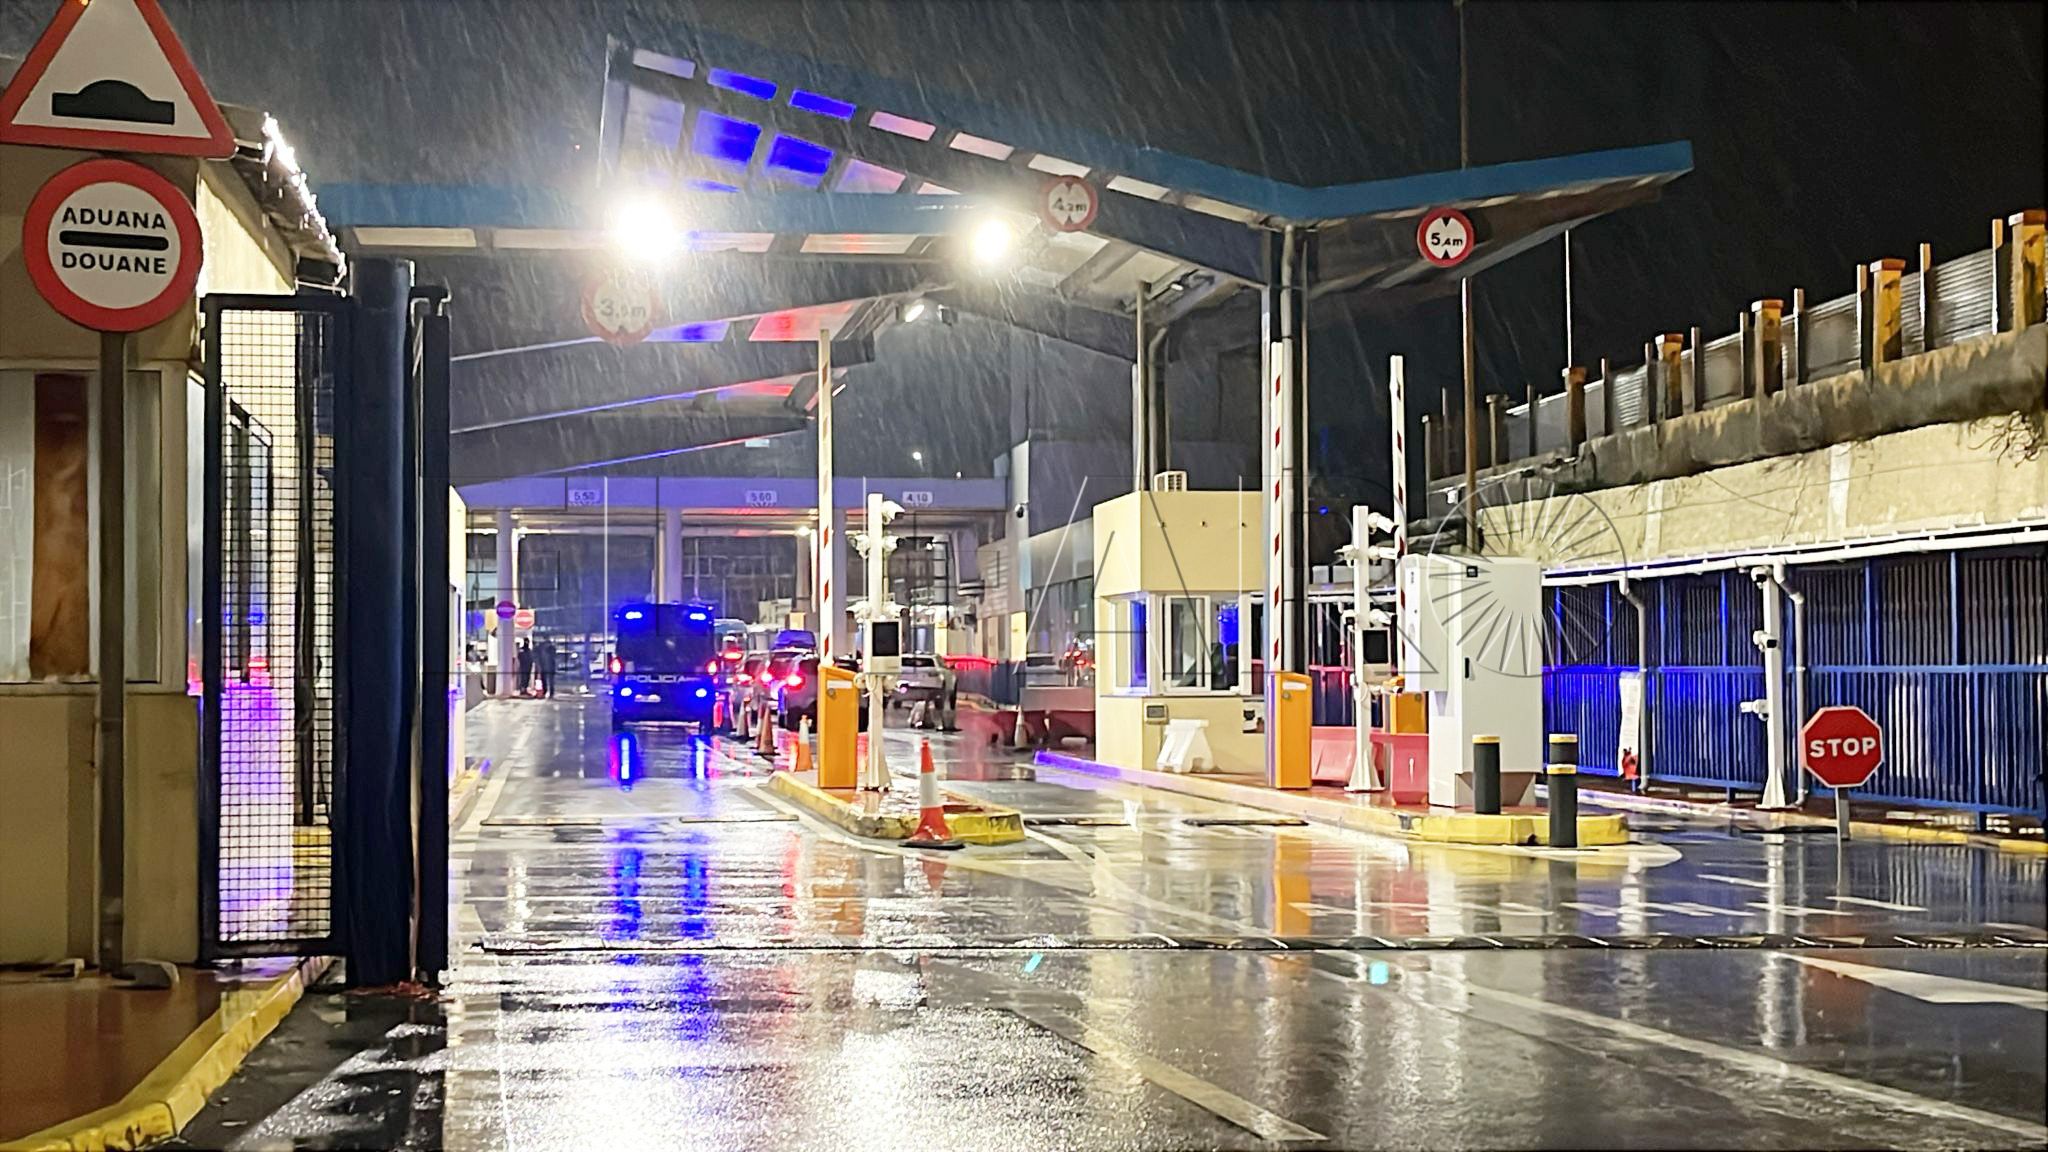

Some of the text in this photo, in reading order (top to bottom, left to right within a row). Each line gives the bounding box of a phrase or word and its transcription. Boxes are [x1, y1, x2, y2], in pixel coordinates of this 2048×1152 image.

[62, 207, 167, 230] ADUANA
[62, 252, 167, 275] DOUANE
[1809, 737, 1877, 758] STOP
